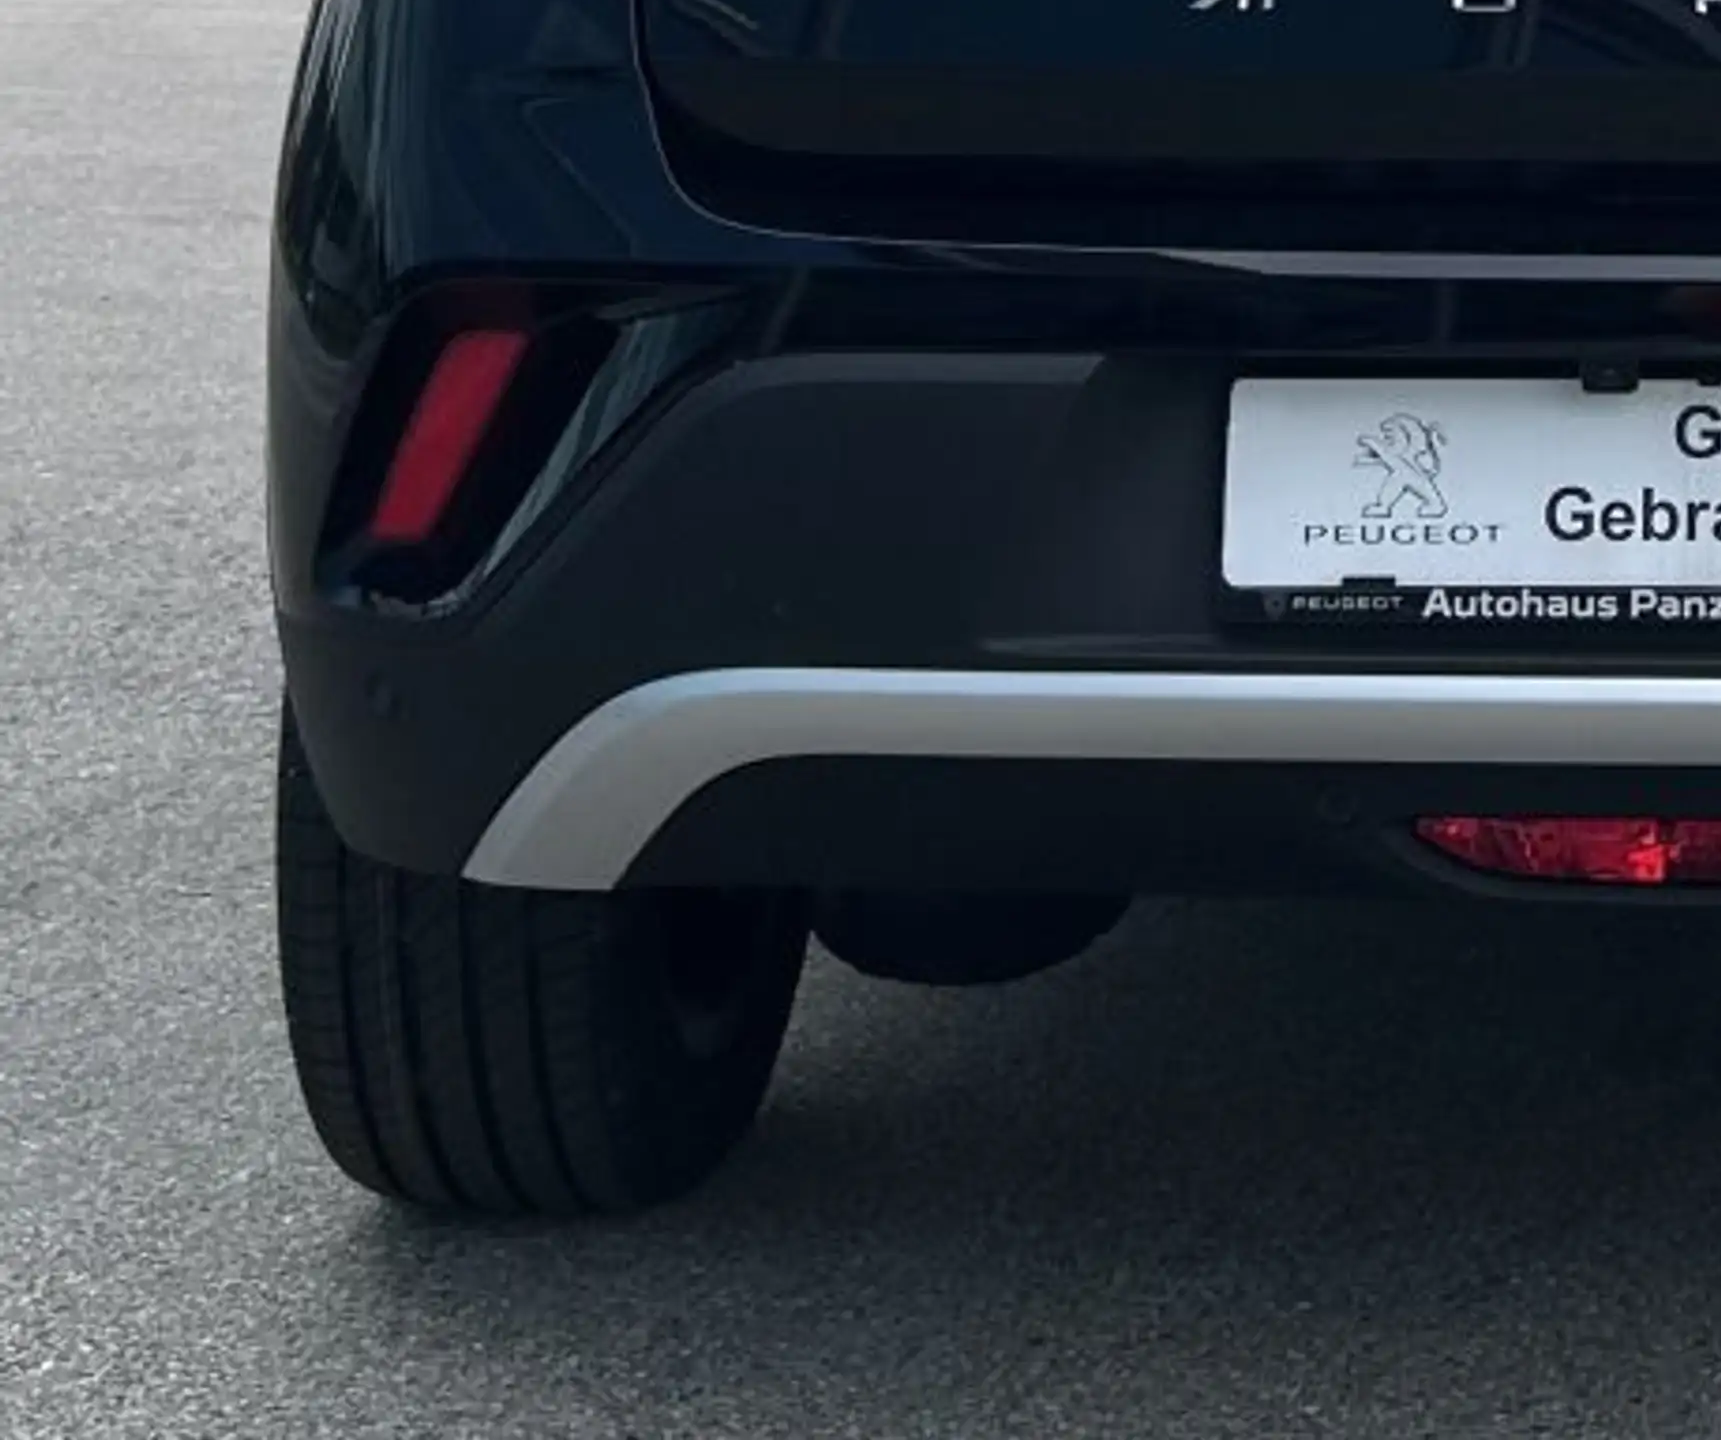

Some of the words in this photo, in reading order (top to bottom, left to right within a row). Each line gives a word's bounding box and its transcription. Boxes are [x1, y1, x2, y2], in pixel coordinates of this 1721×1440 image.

[1303, 523, 1503, 547] PEUGEOT
[1291, 594, 1403, 611] PEUGEOT
[1422, 587, 1619, 619] Autohaus
